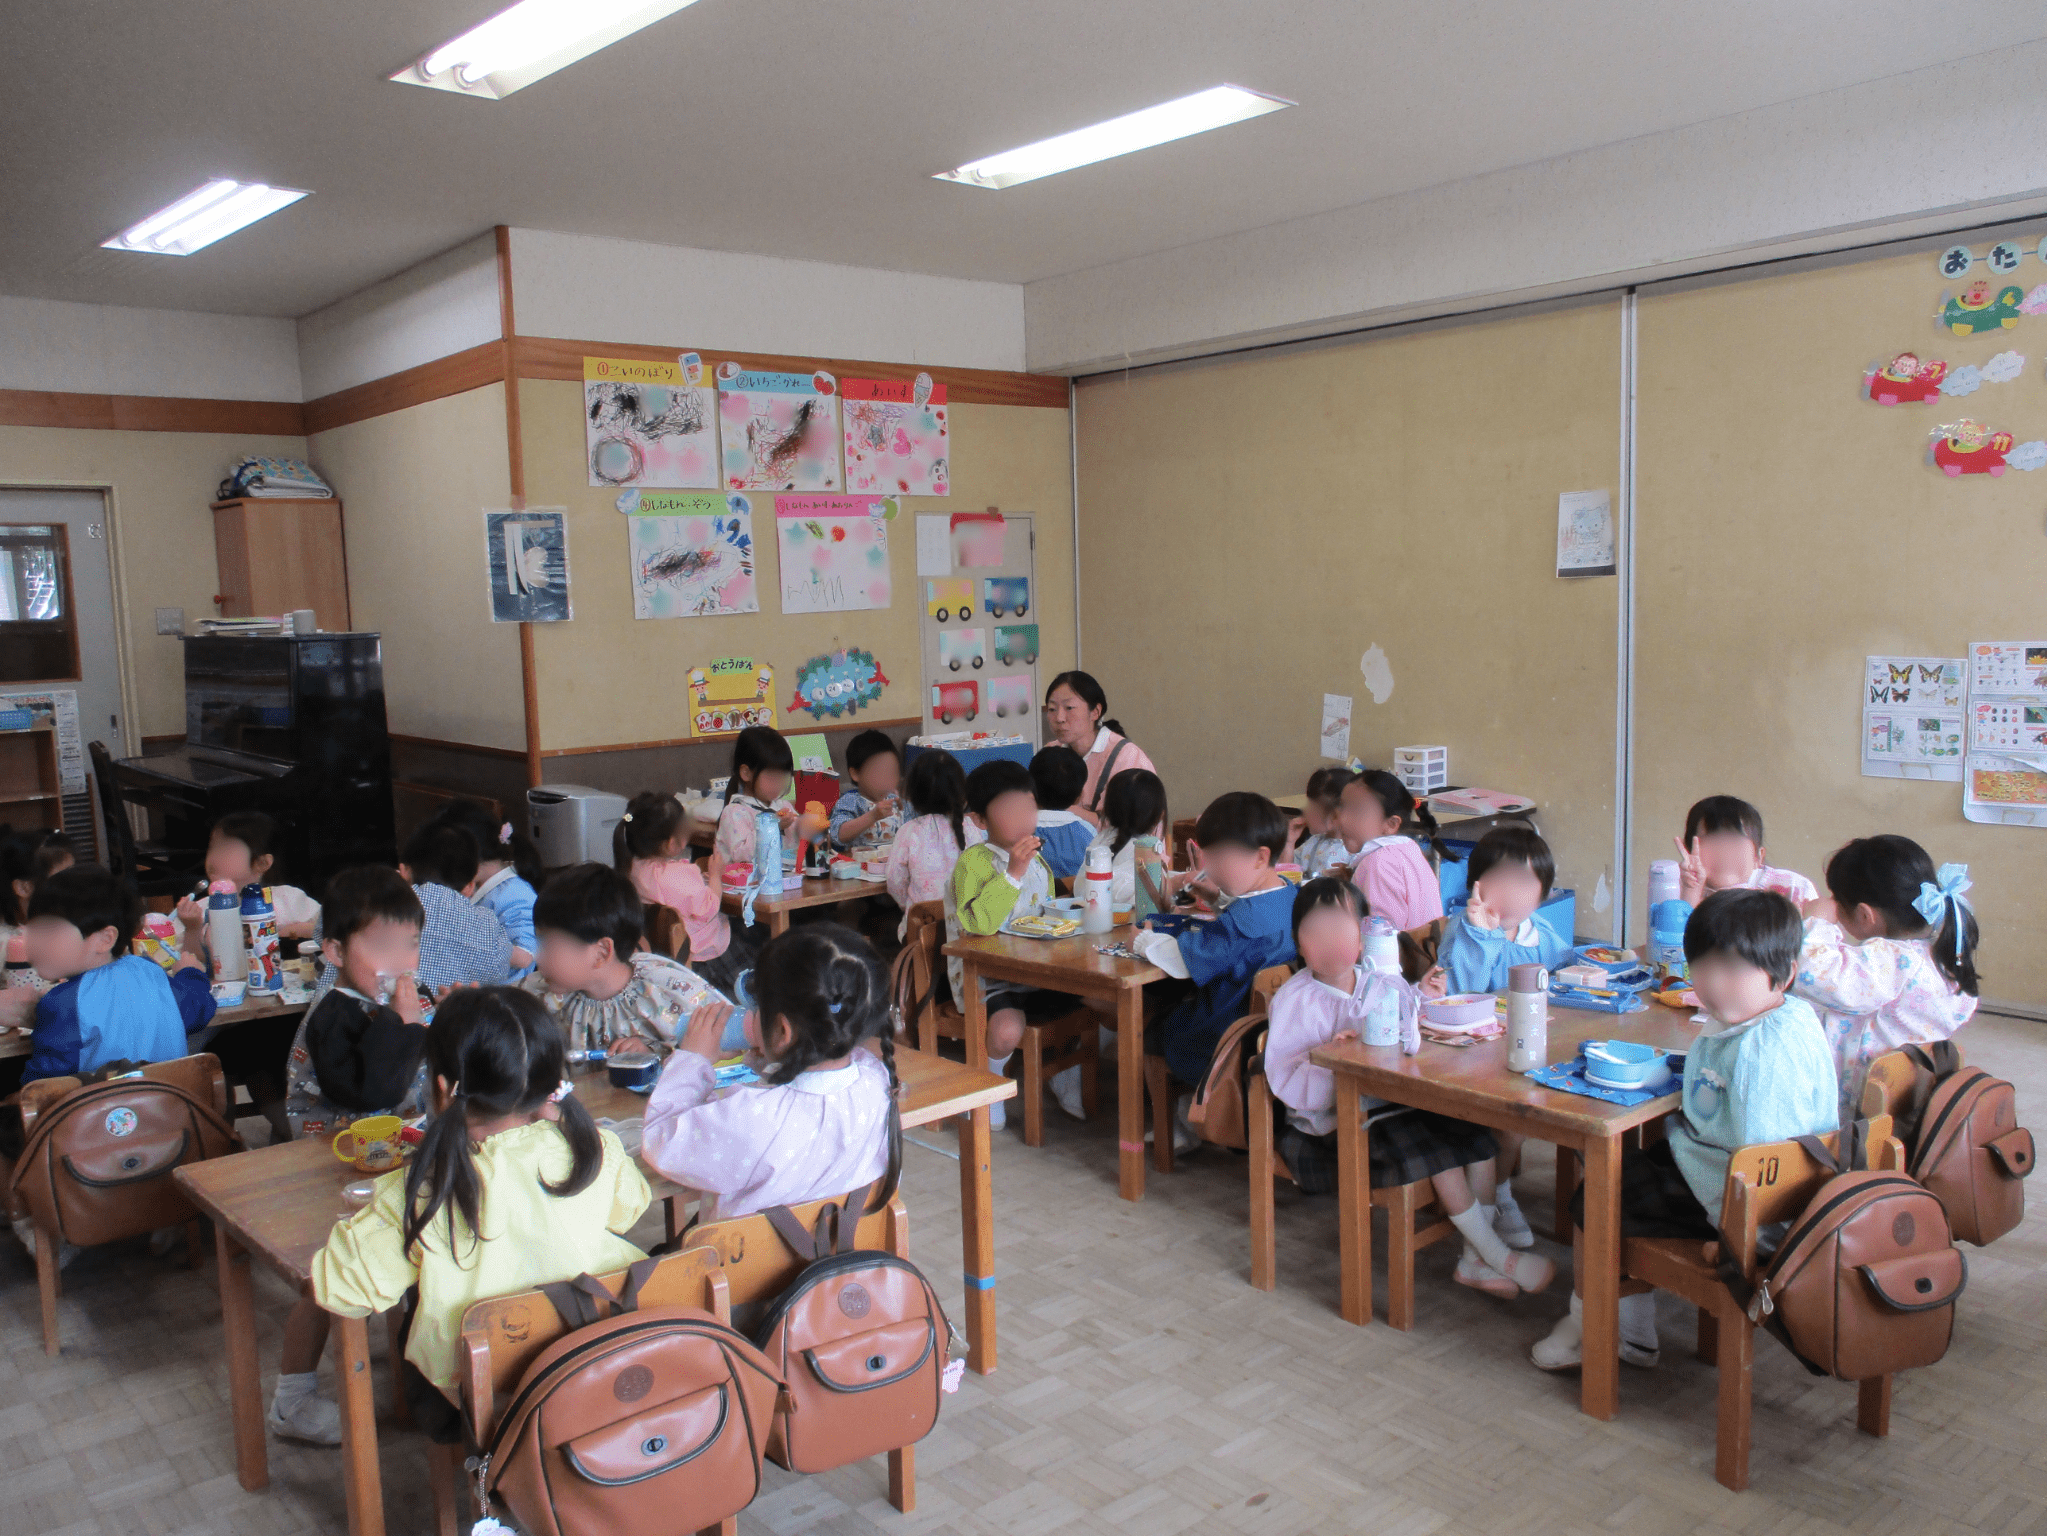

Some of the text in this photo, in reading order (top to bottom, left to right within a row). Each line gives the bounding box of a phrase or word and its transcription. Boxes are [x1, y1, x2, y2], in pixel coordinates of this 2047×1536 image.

[1930, 364, 1942, 379] 7
[1993, 435, 2010, 452] 11
[711, 658, 753, 673] おとうばん
[1757, 1155, 1779, 1187] 10
